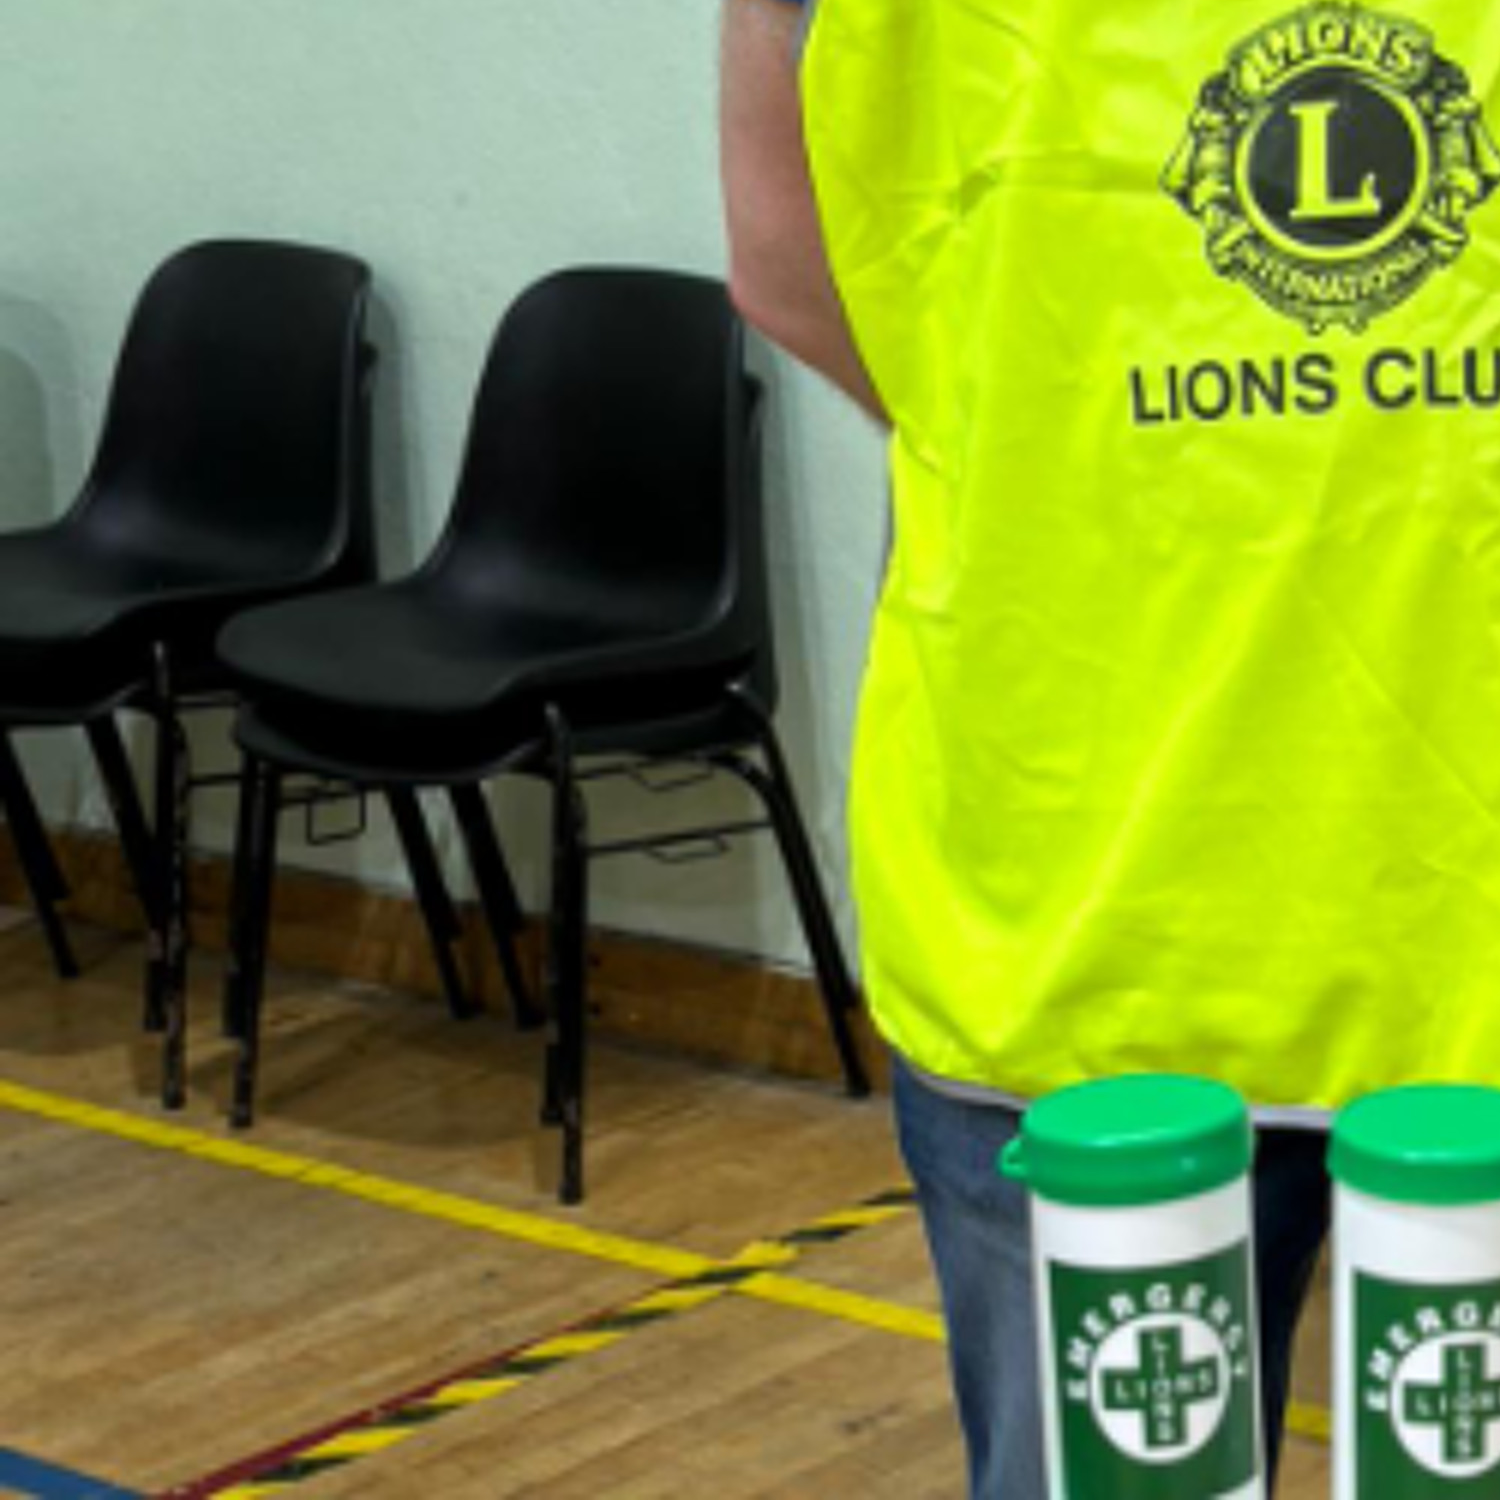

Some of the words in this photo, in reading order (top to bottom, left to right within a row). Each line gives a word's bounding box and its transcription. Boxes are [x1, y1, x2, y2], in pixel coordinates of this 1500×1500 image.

[1240, 8, 1422, 96] LIONS
[1289, 101, 1381, 220] L
[1129, 352, 1338, 424] LIONS
[1066, 1282, 1249, 1400] EMERGENCY
